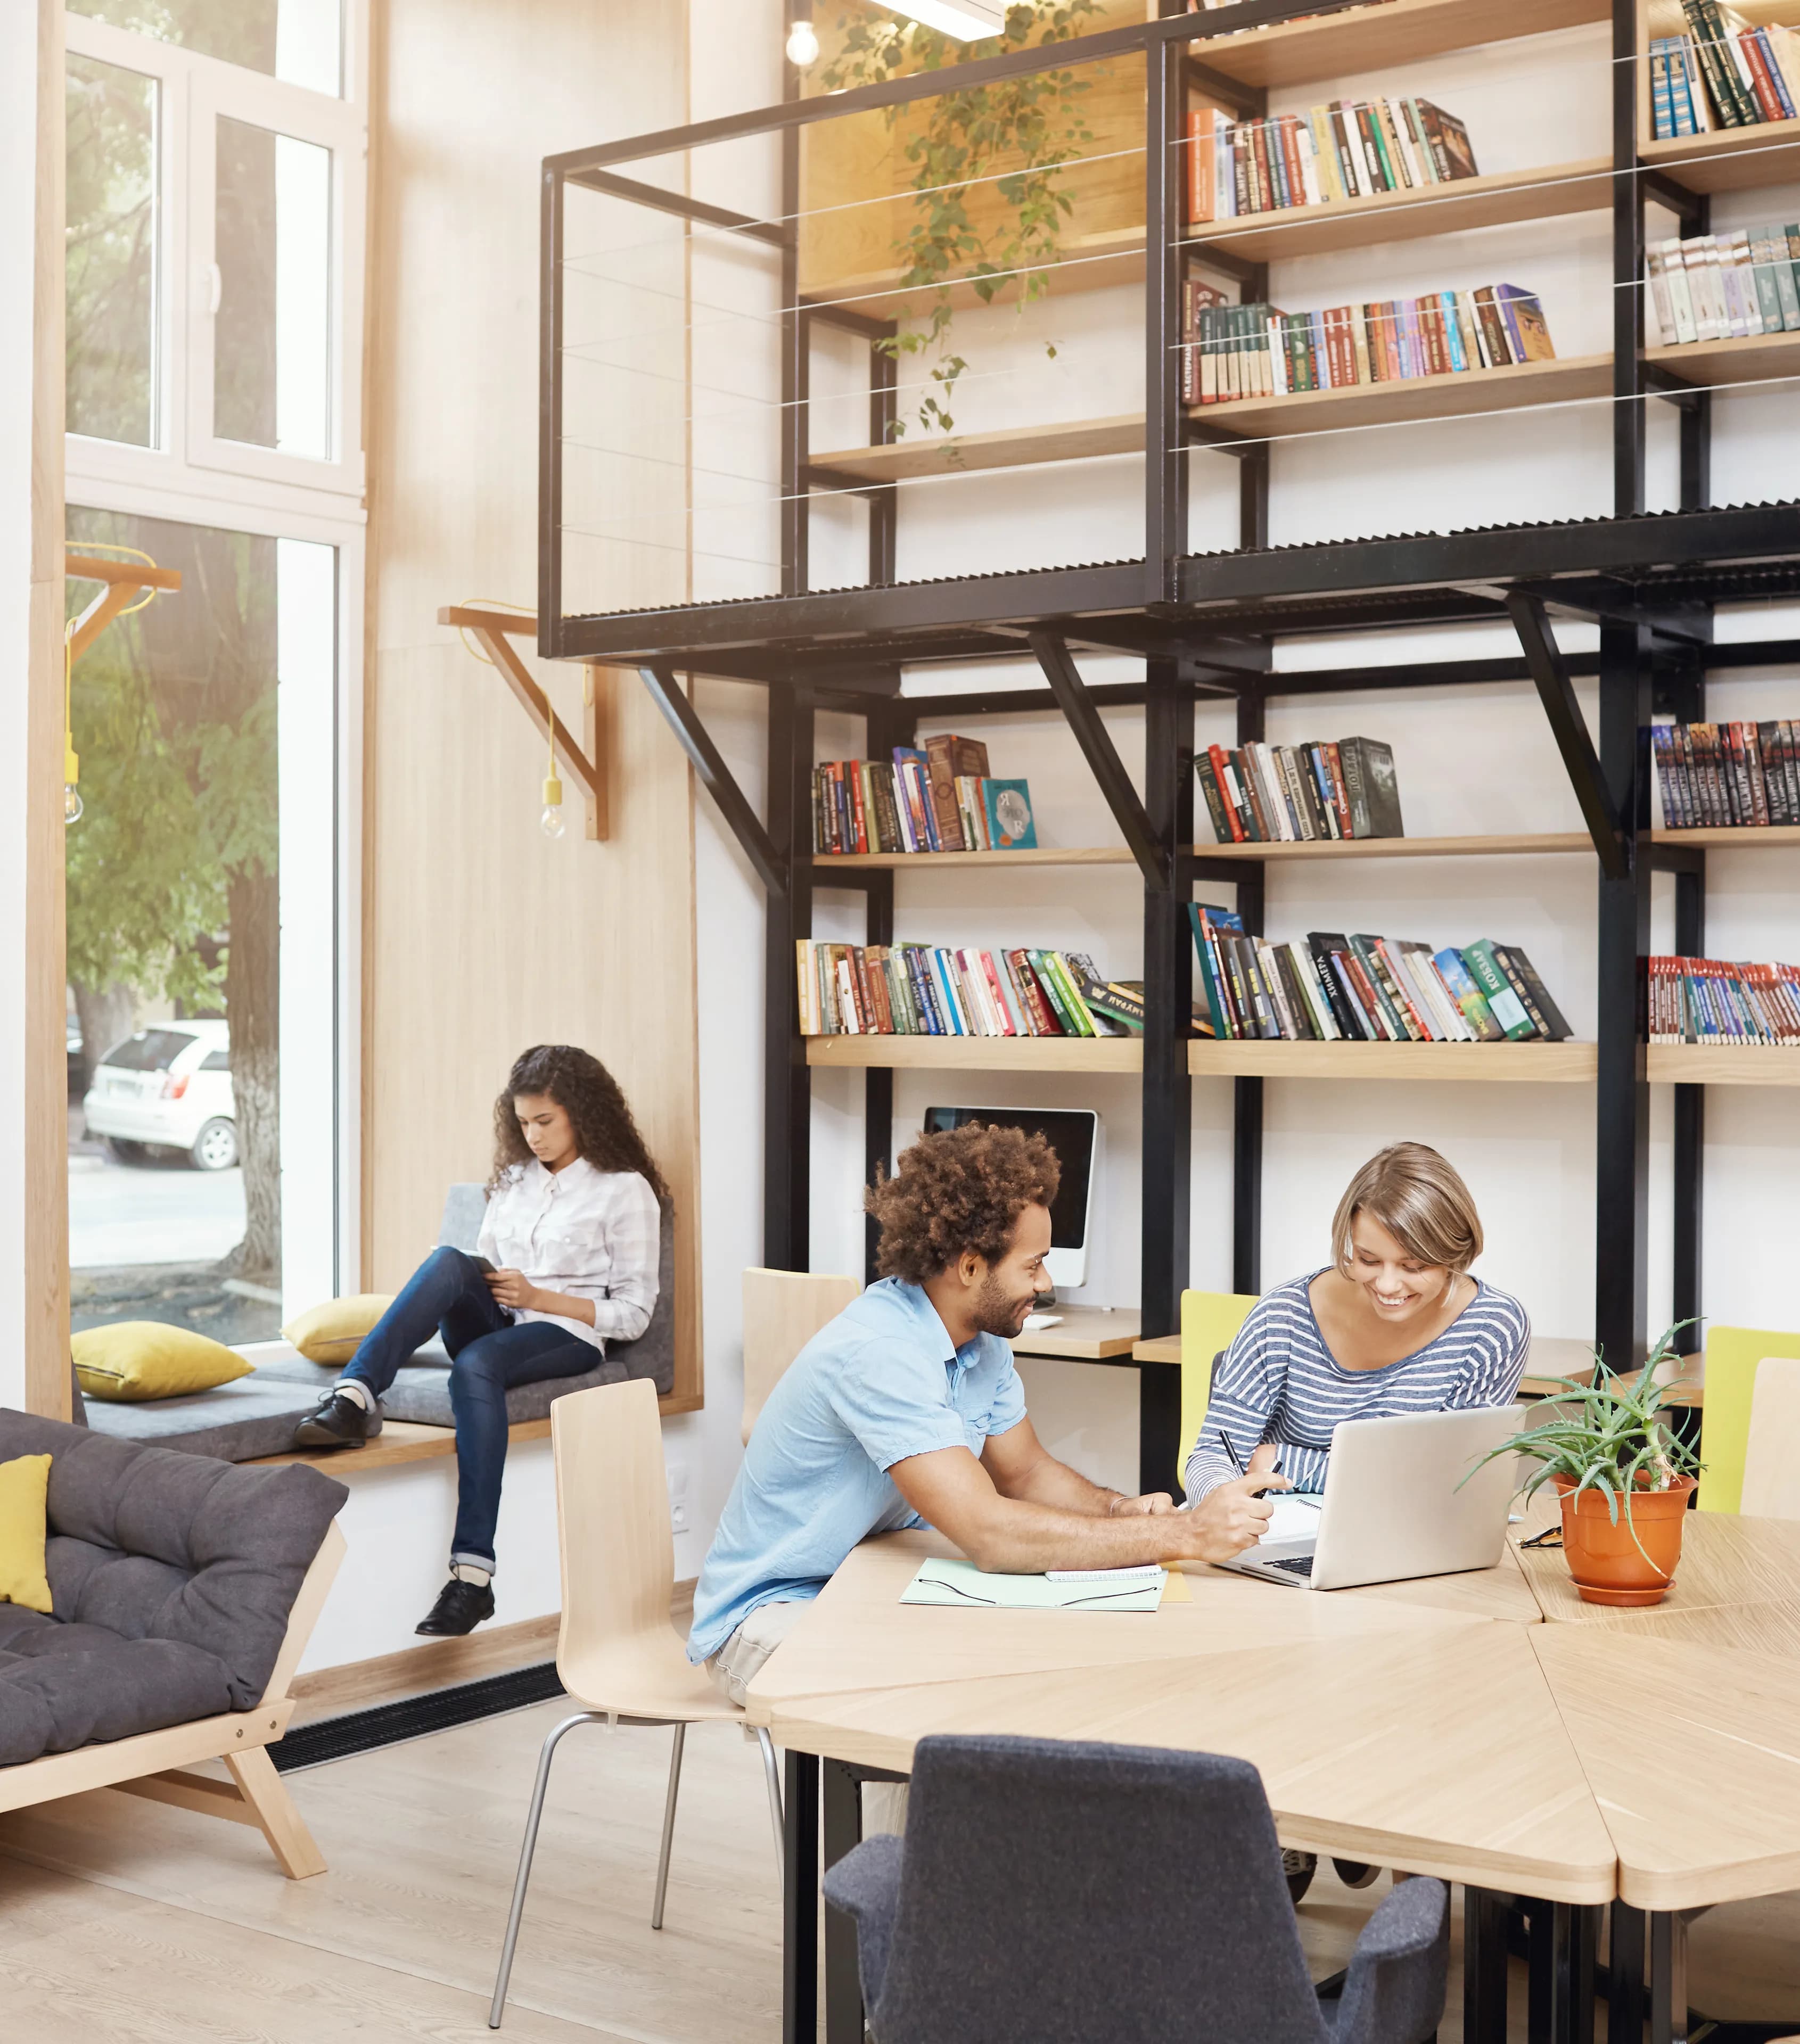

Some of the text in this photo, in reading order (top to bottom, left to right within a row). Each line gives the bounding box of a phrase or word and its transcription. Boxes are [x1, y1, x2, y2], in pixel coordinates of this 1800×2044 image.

[1000, 793, 1010, 806] Я
[1014, 820, 1024, 834] R
[1317, 955, 1338, 998] ХИМЕРА
[1472, 950, 1500, 990] КОБЗАР
